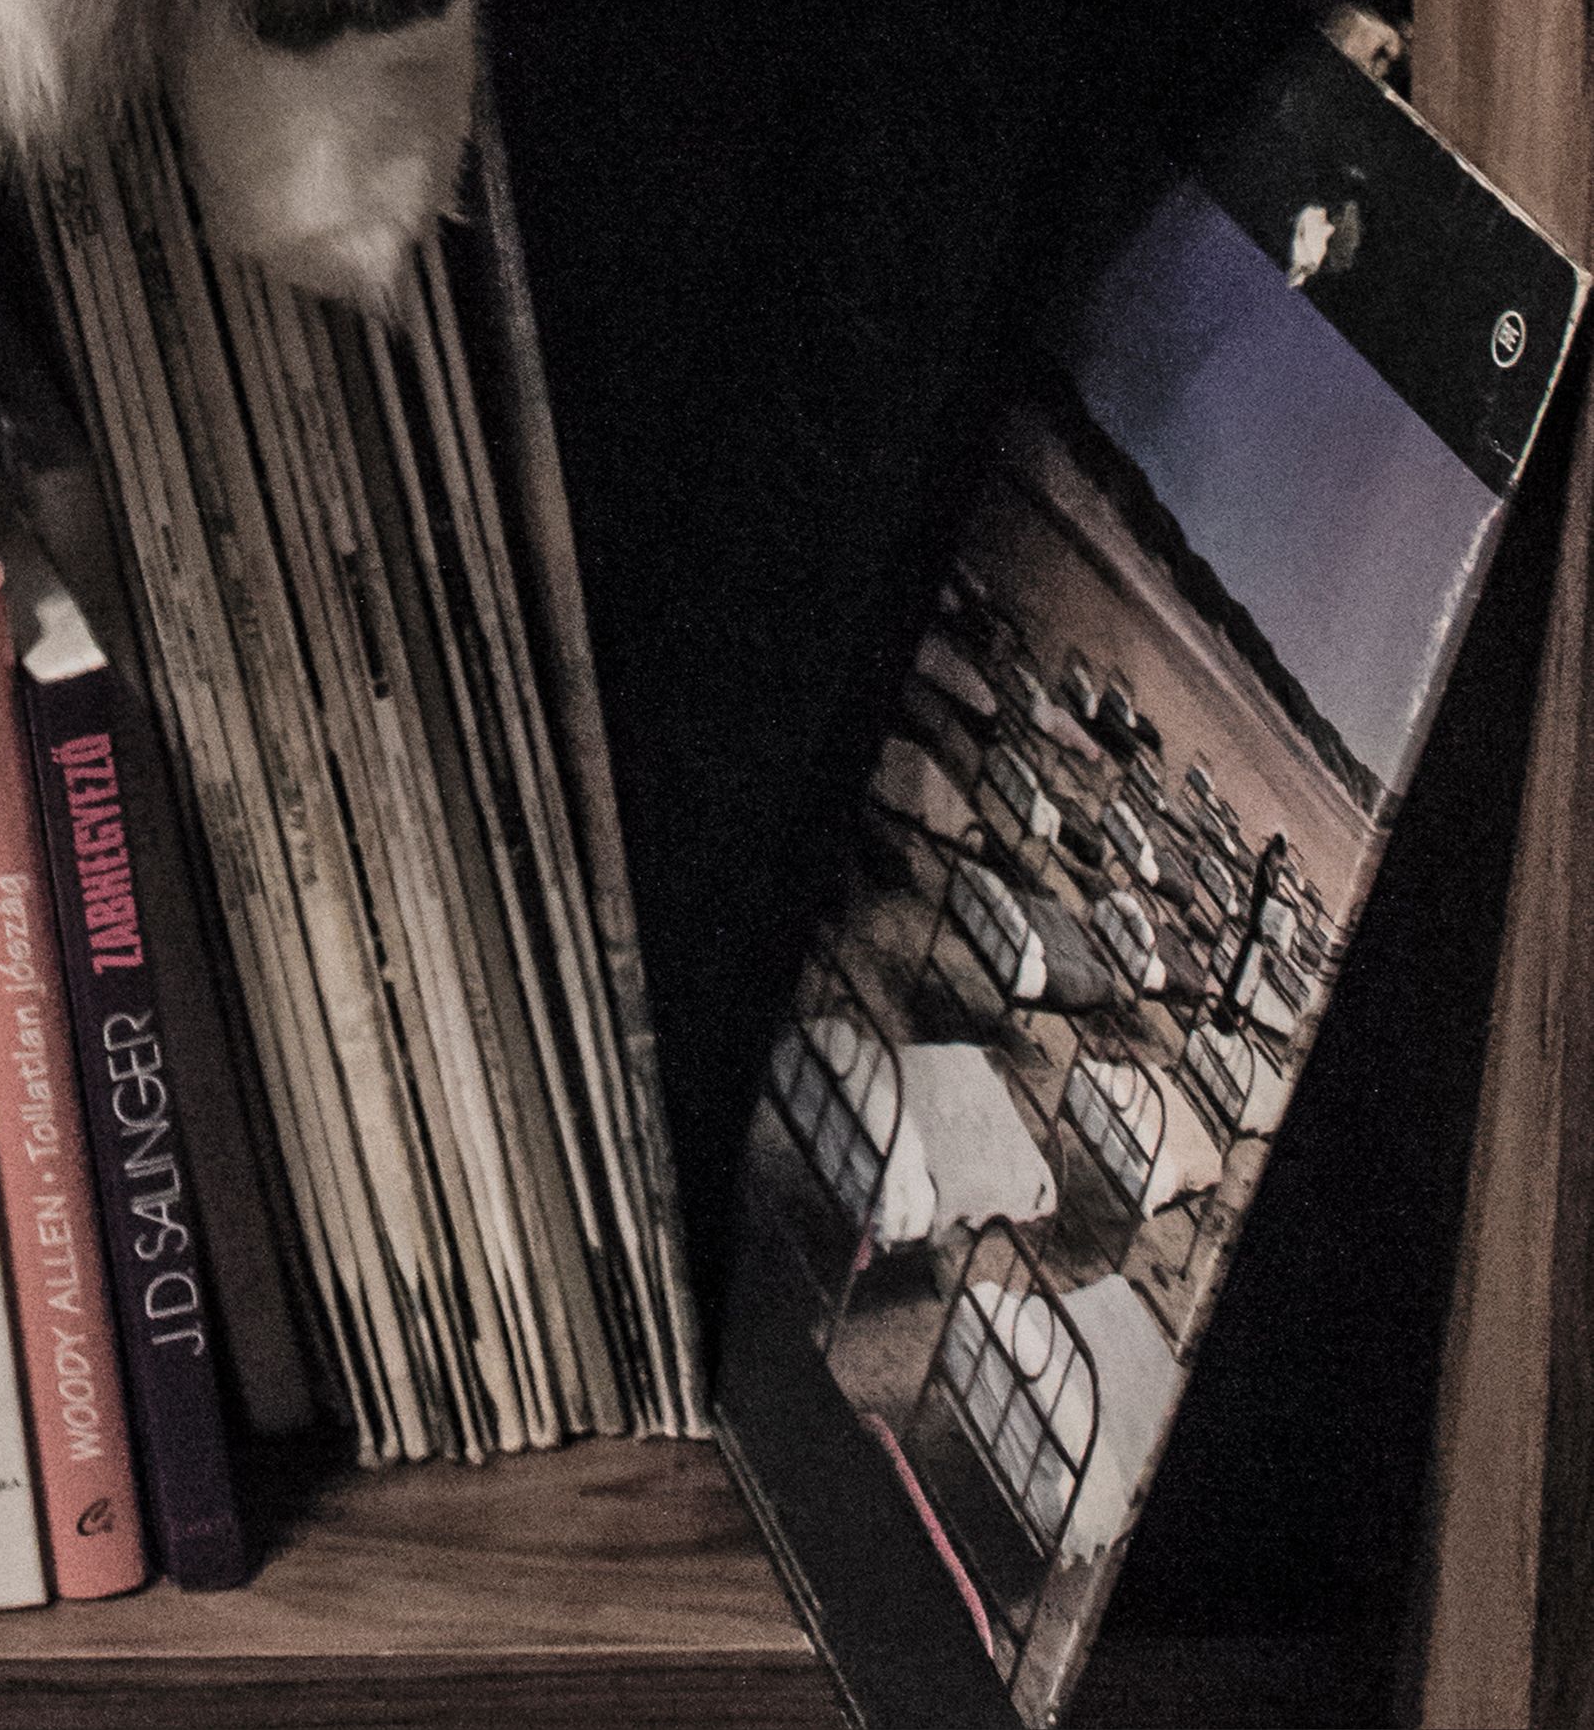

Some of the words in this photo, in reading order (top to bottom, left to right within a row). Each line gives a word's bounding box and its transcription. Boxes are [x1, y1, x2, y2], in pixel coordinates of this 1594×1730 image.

[51, 732, 146, 976] ZABHEGYEZŐ
[101, 1008, 192, 1263] SALINGER
[34, 1192, 84, 1315] ALLEN
[56, 1329, 105, 1463] WOODY
